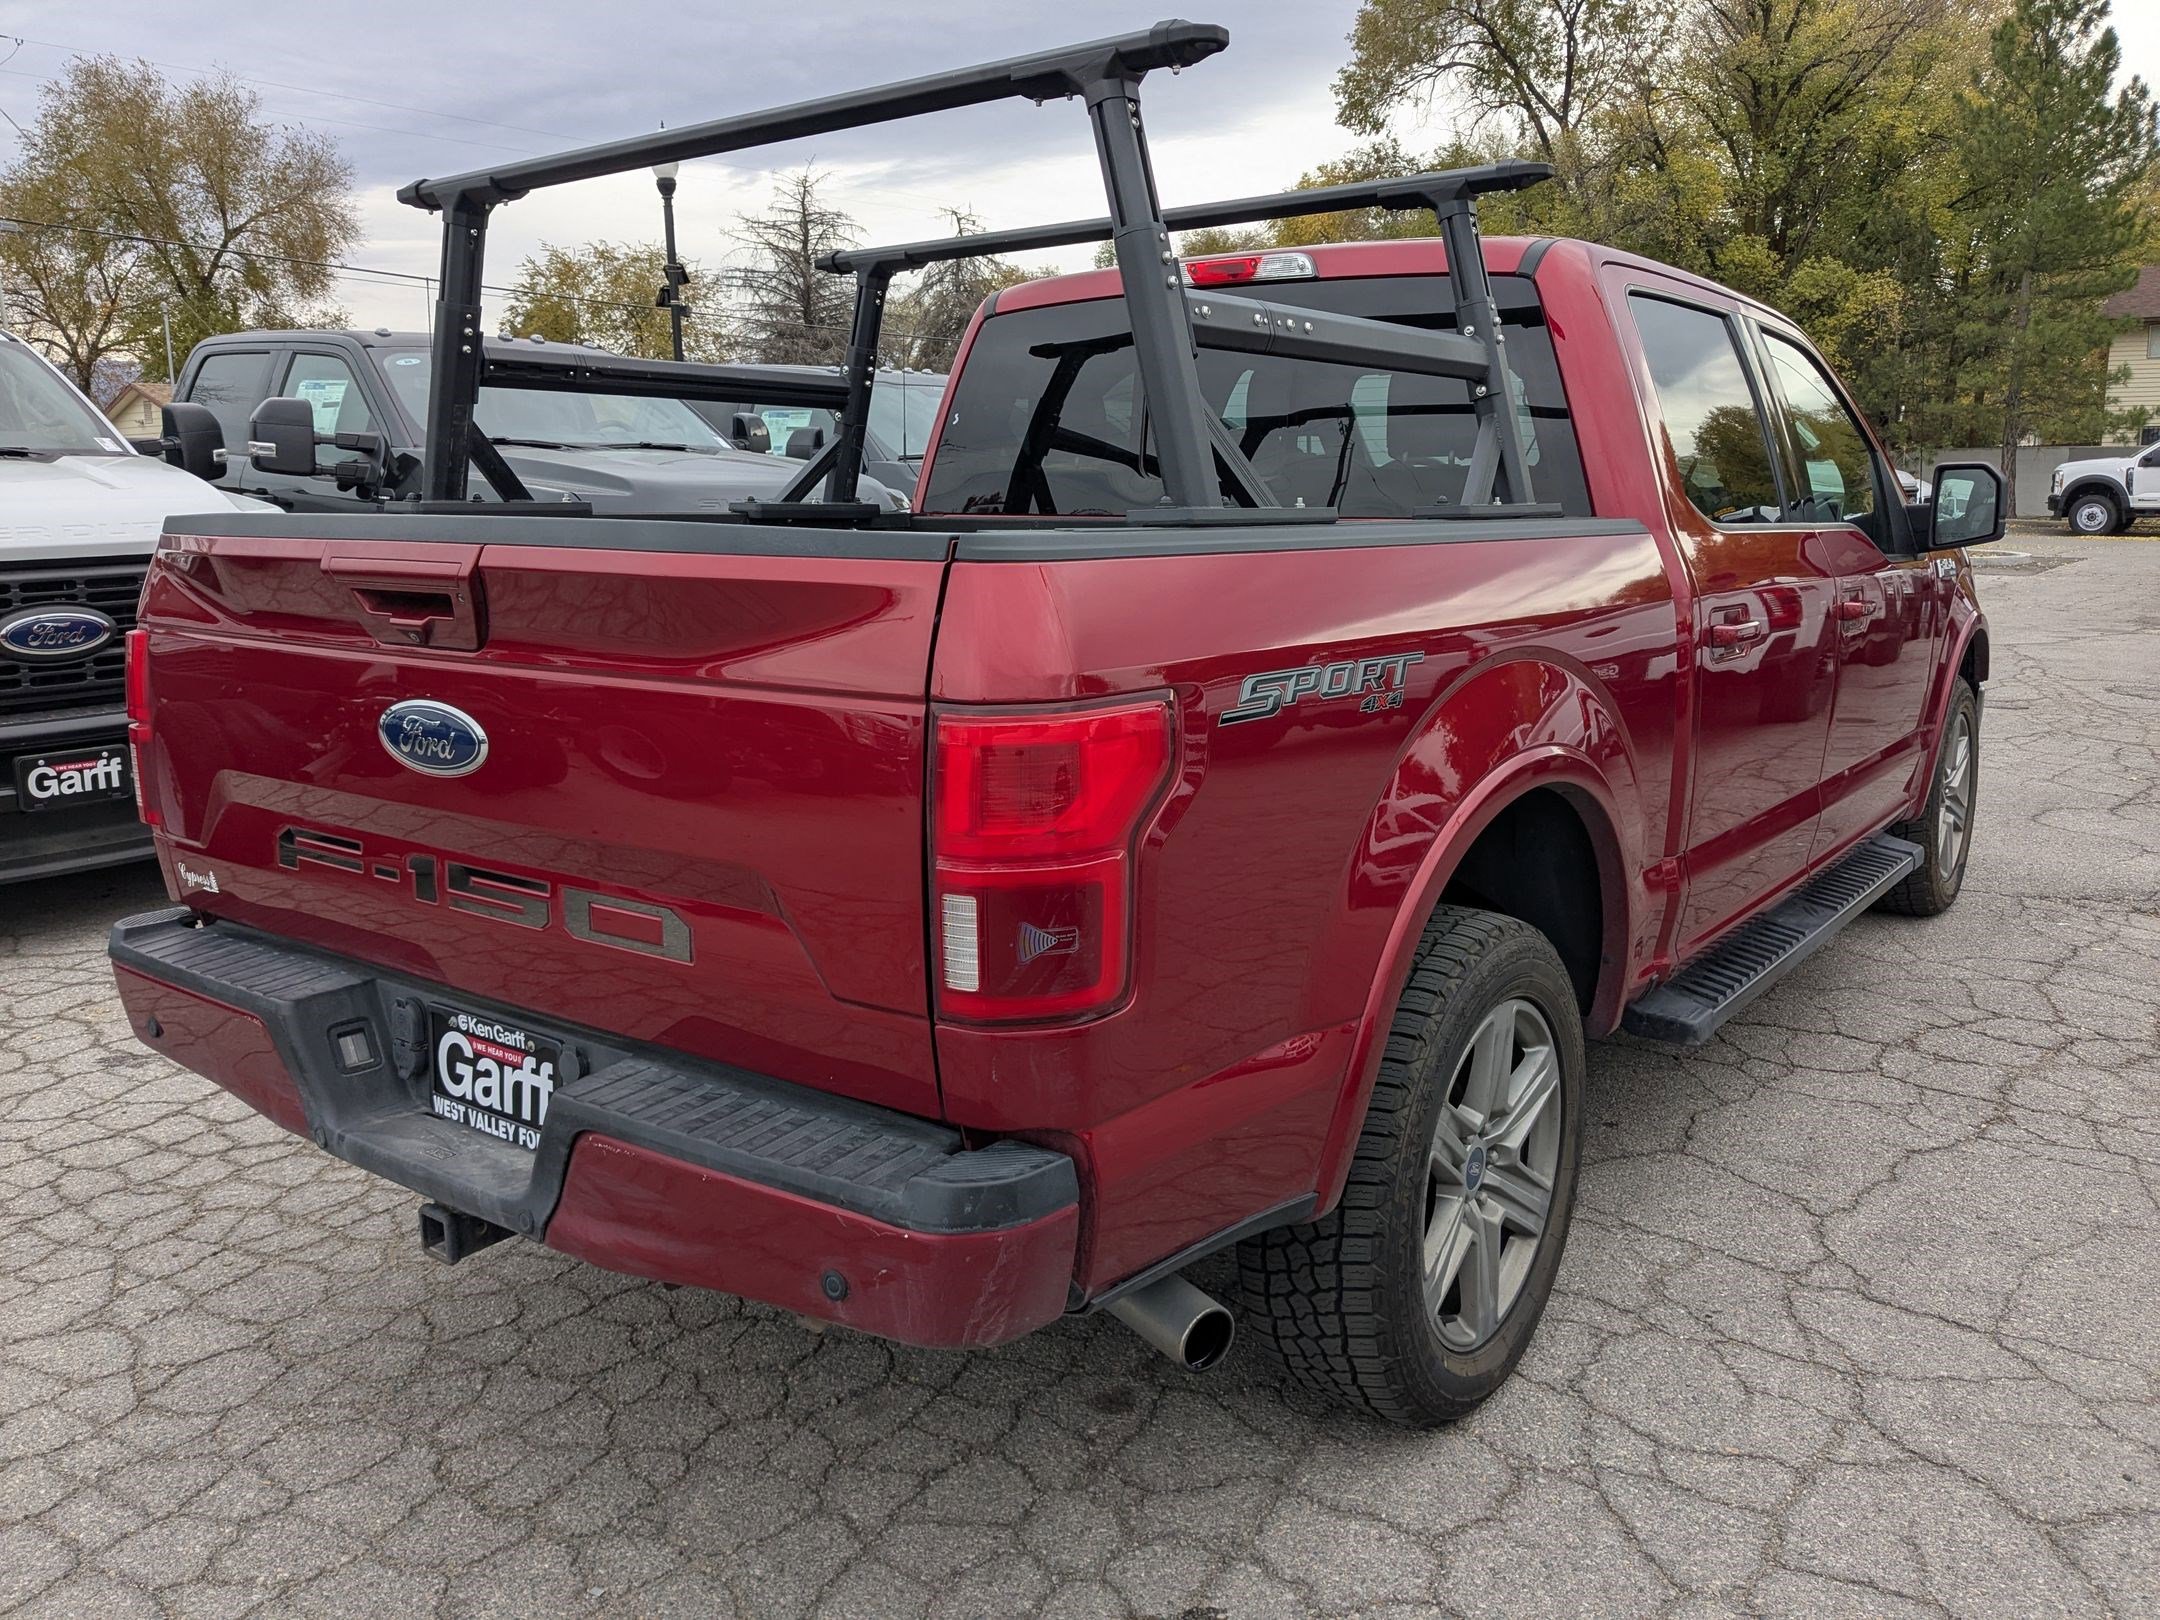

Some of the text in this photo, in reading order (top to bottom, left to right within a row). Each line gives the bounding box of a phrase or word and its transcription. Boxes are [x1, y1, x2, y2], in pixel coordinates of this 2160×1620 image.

[27, 621, 87, 647] Ford
[1218, 651, 1425, 727] SPORT
[400, 715, 456, 760] Ford
[27, 757, 122, 799] Garff
[277, 824, 695, 966] F-150
[476, 1042, 518, 1063] WE HEAR YOU
[438, 1031, 554, 1127] Garff
[433, 1095, 541, 1151] WEST VALLEY FO
